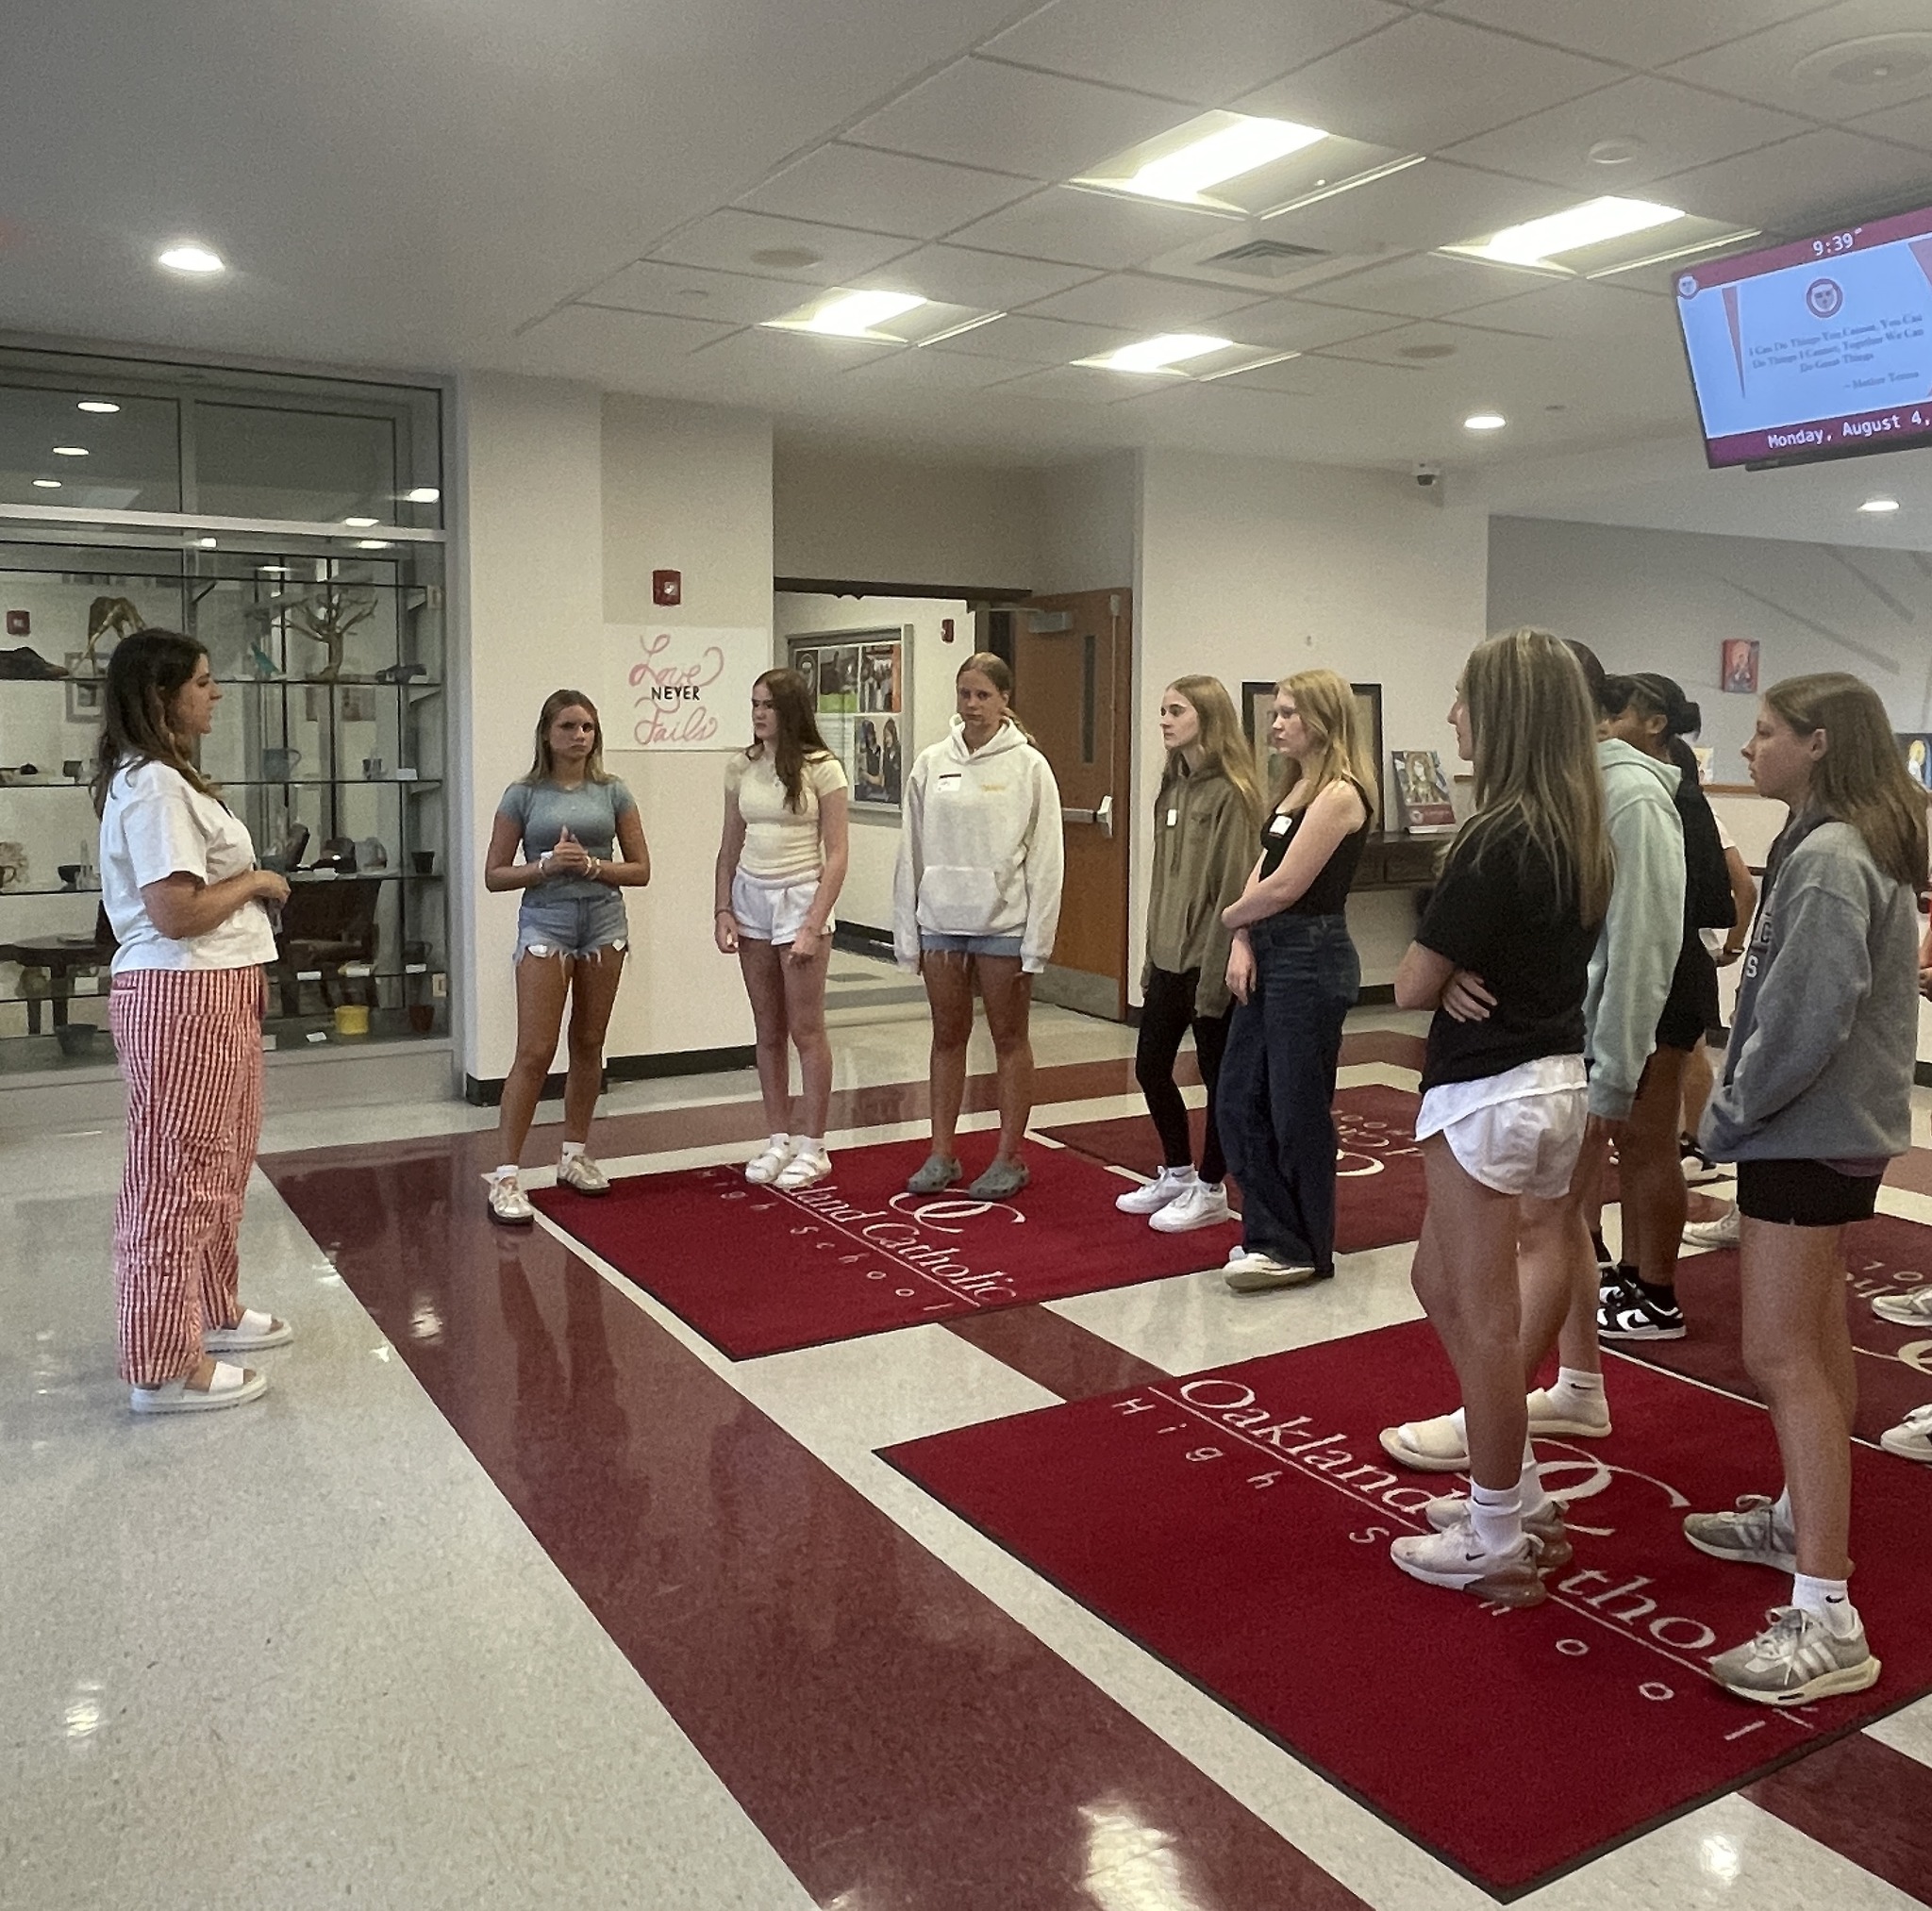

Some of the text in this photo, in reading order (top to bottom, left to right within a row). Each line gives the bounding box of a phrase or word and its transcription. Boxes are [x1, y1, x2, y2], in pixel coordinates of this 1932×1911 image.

[1812, 232, 1854, 256] 9:39
[1767, 428, 1833, 450] Monday,
[1842, 414, 1902, 437] August
[629, 633, 725, 688] Love
[651, 685, 701, 701] NEVER
[634, 696, 718, 746] Fails
[861, 1222, 1017, 1302] Catholic
[1111, 1397, 1284, 1490] High
[1179, 1378, 1467, 1515] Oakland
